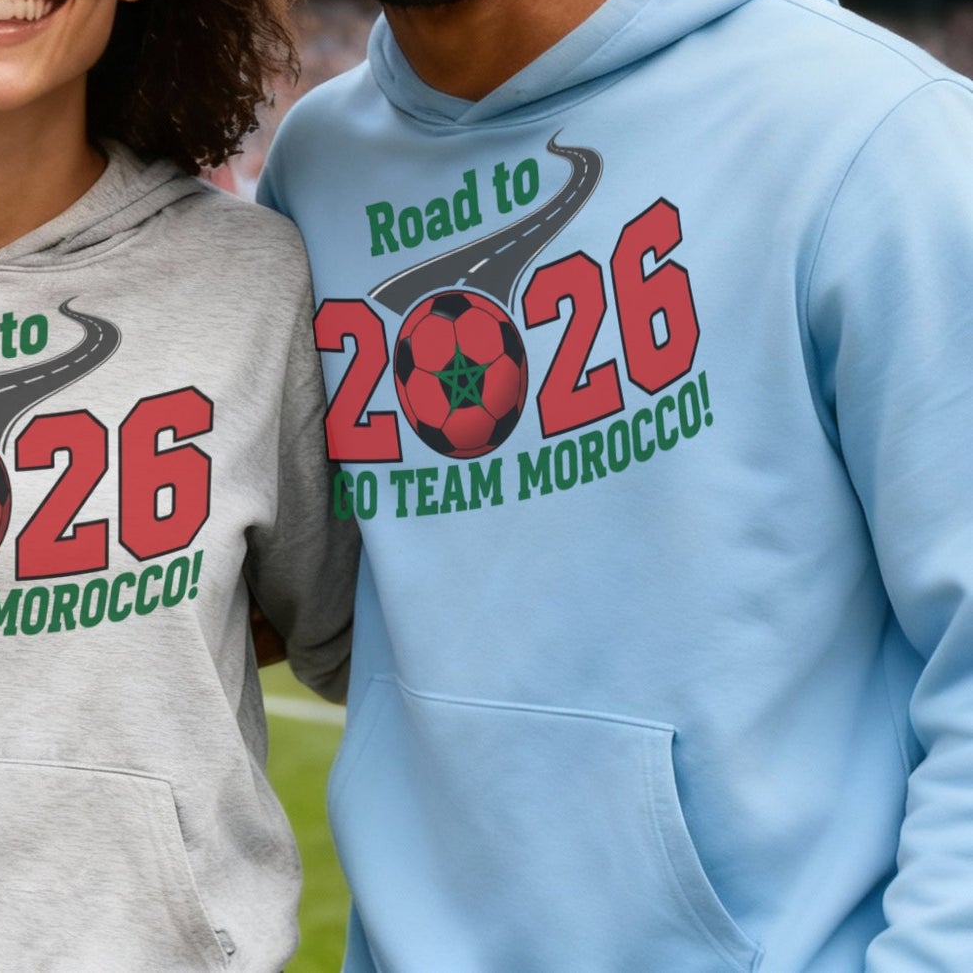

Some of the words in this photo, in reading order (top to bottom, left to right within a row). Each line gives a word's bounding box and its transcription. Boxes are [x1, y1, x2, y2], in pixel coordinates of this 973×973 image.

[365, 169, 482, 257] Road
[492, 157, 540, 214] to
[0, 311, 49, 358] to
[312, 197, 700, 463] 2026
[333, 470, 377, 521] GO
[390, 457, 503, 518] TEAM
[518, 370, 714, 501] MOROCCO!
